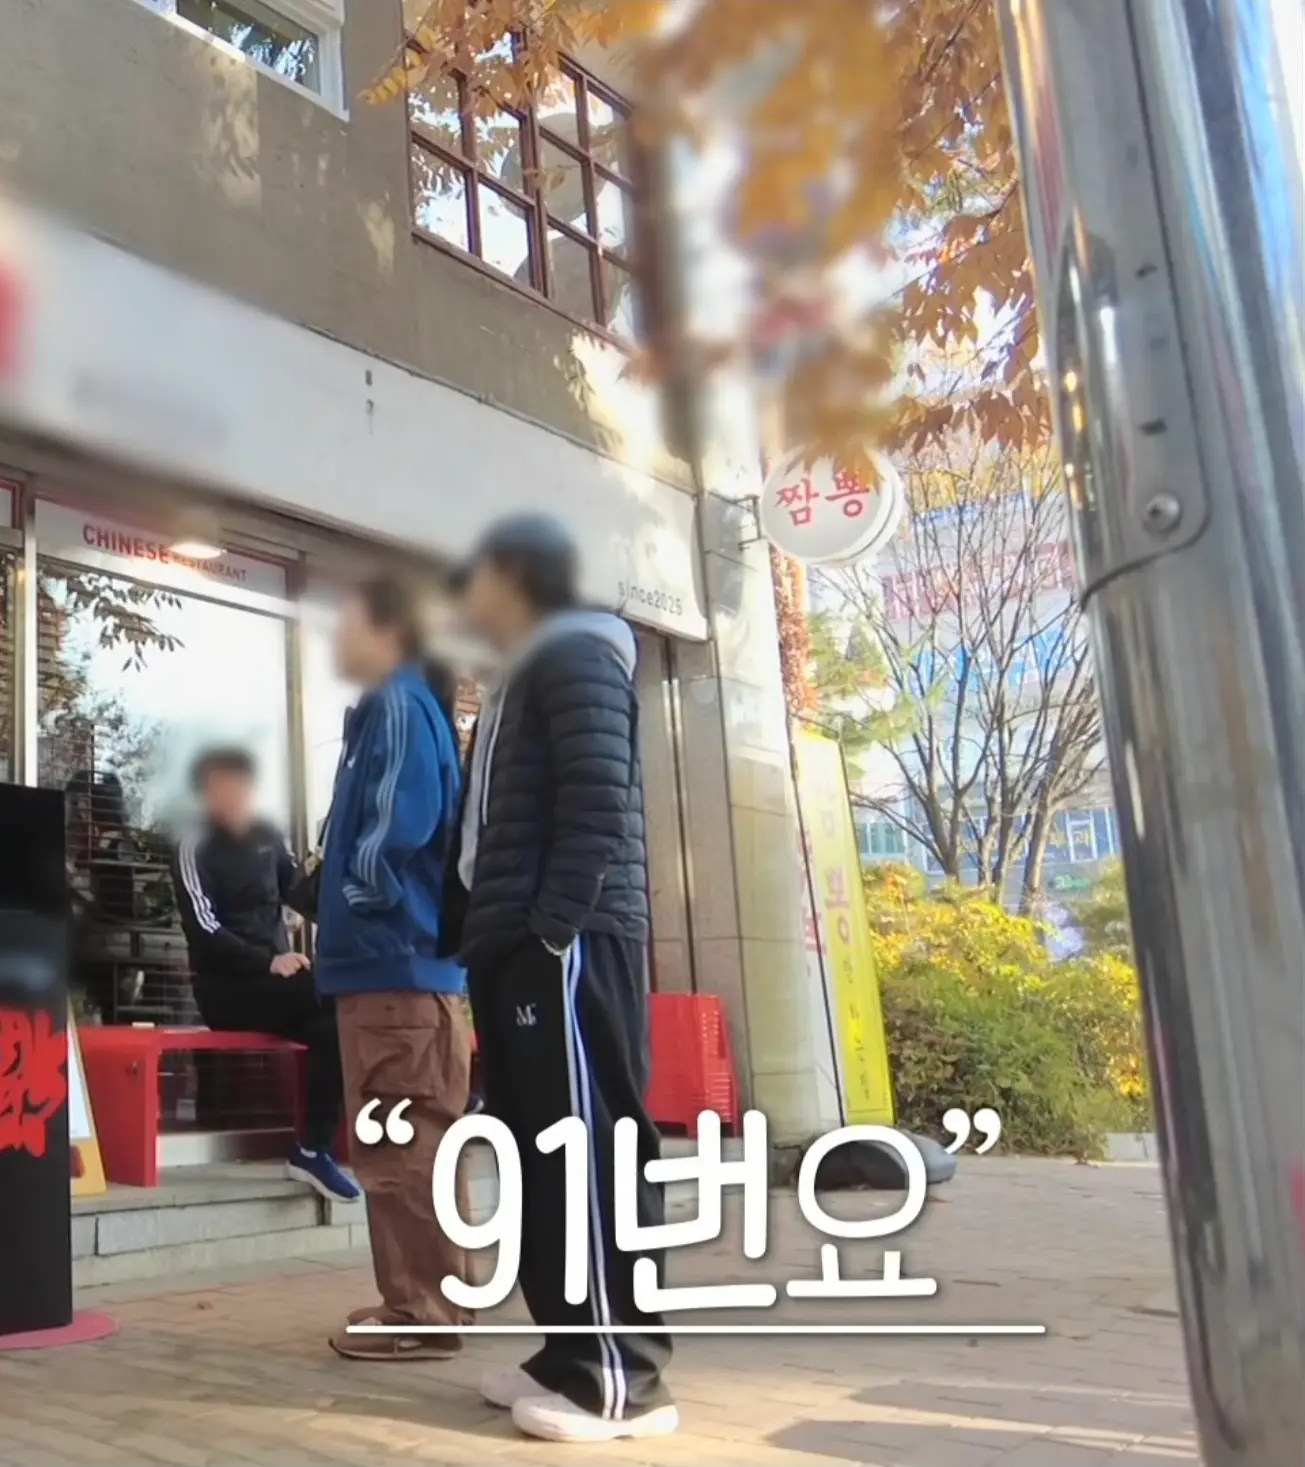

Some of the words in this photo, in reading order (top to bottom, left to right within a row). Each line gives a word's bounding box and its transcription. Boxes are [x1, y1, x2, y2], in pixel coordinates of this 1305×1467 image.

[774, 469, 870, 527] 짬뽕
[82, 523, 170, 565] CHINESE
[618, 580, 683, 616] since2025
